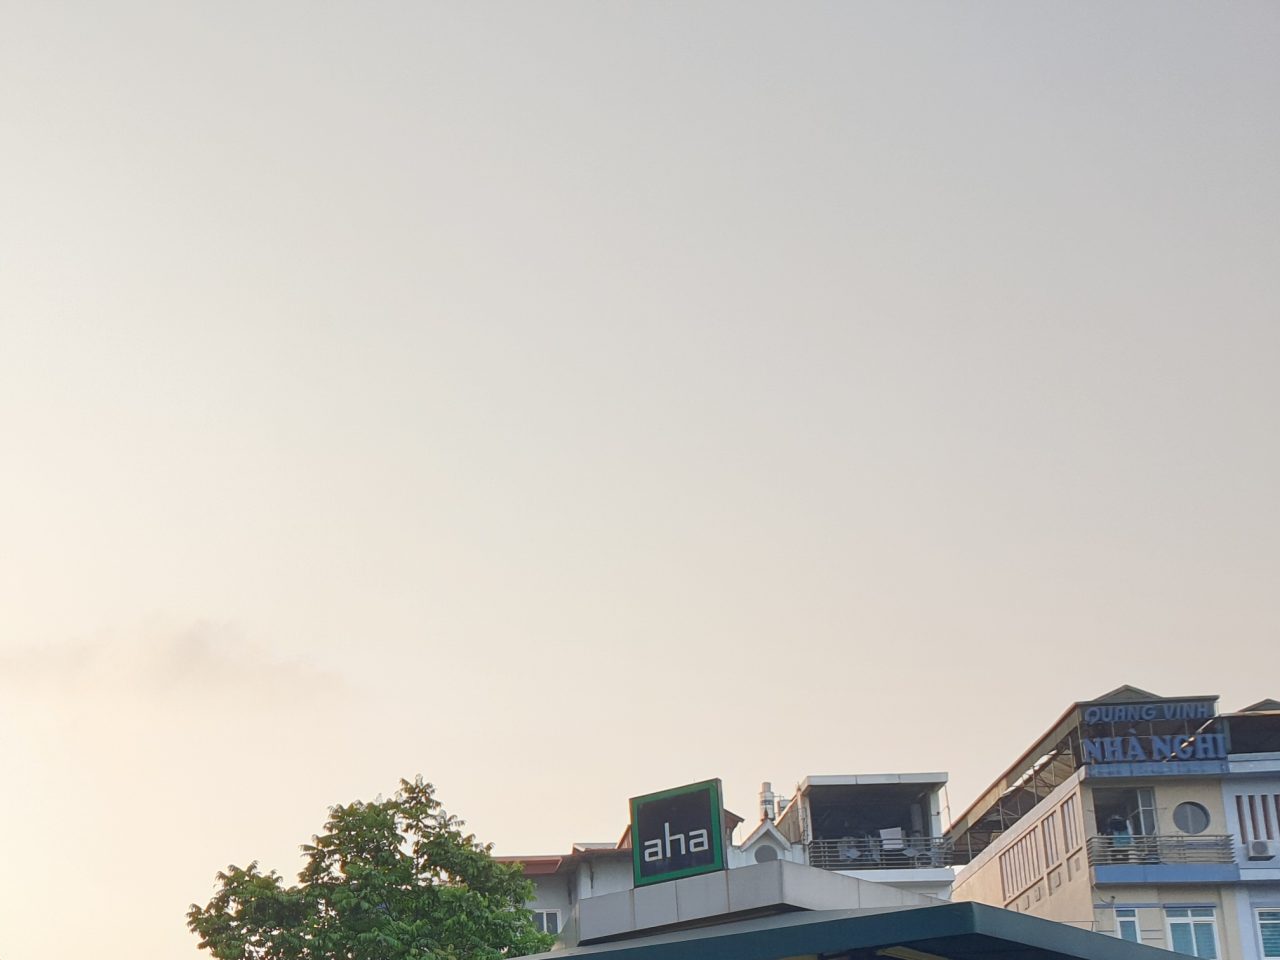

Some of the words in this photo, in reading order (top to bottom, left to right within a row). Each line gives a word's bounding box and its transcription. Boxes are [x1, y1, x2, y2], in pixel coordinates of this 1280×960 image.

[1084, 703, 1156, 725] QUANG
[1164, 702, 1209, 719] VINH
[643, 822, 709, 862] aha
